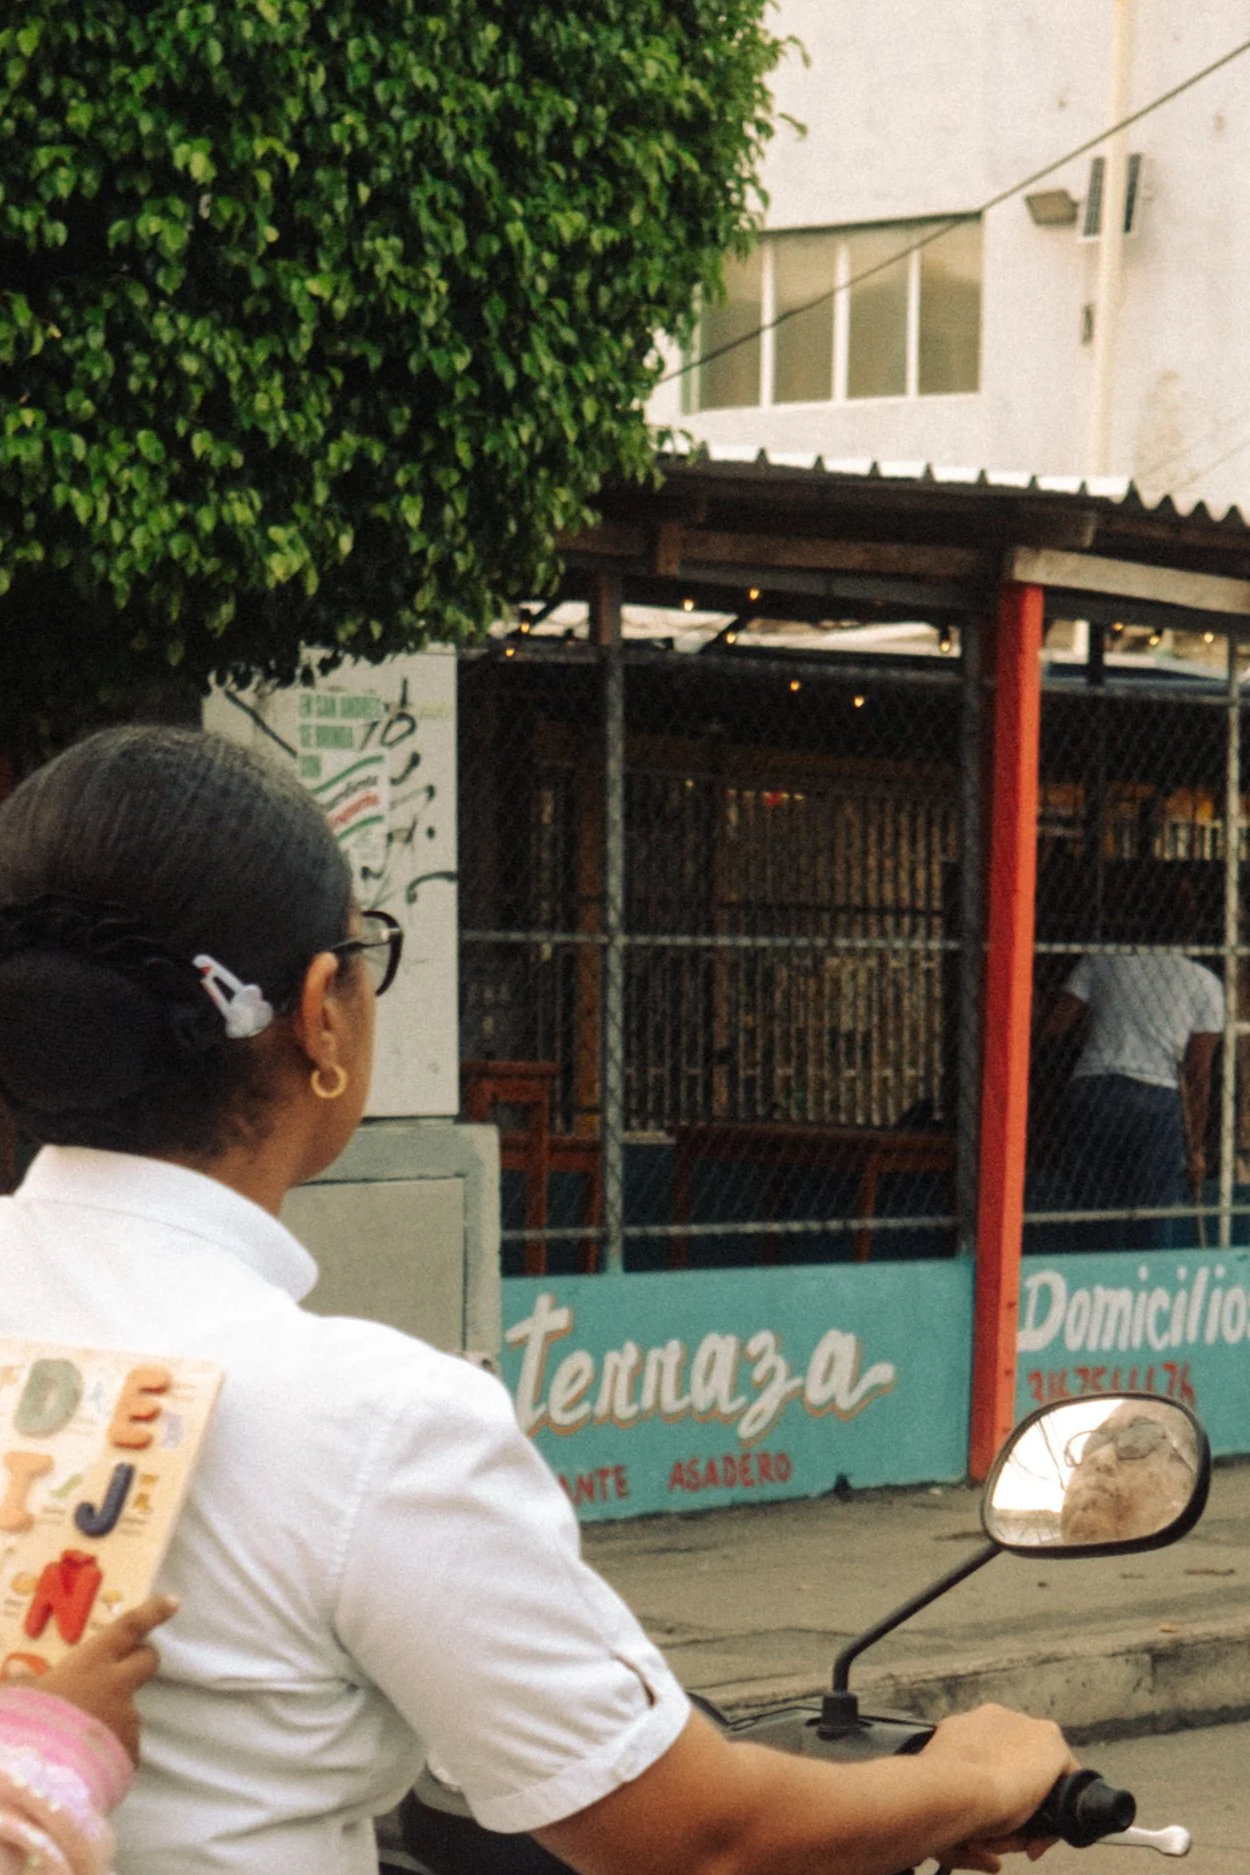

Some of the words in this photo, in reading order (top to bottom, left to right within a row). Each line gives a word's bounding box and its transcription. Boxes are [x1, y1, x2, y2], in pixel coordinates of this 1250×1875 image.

[1016, 1264, 1250, 1352] Domicilio
[13, 1358, 83, 1439] D
[106, 1363, 173, 1450] E
[74, 1462, 136, 1539] J
[668, 1452, 793, 1494] ASADERO
